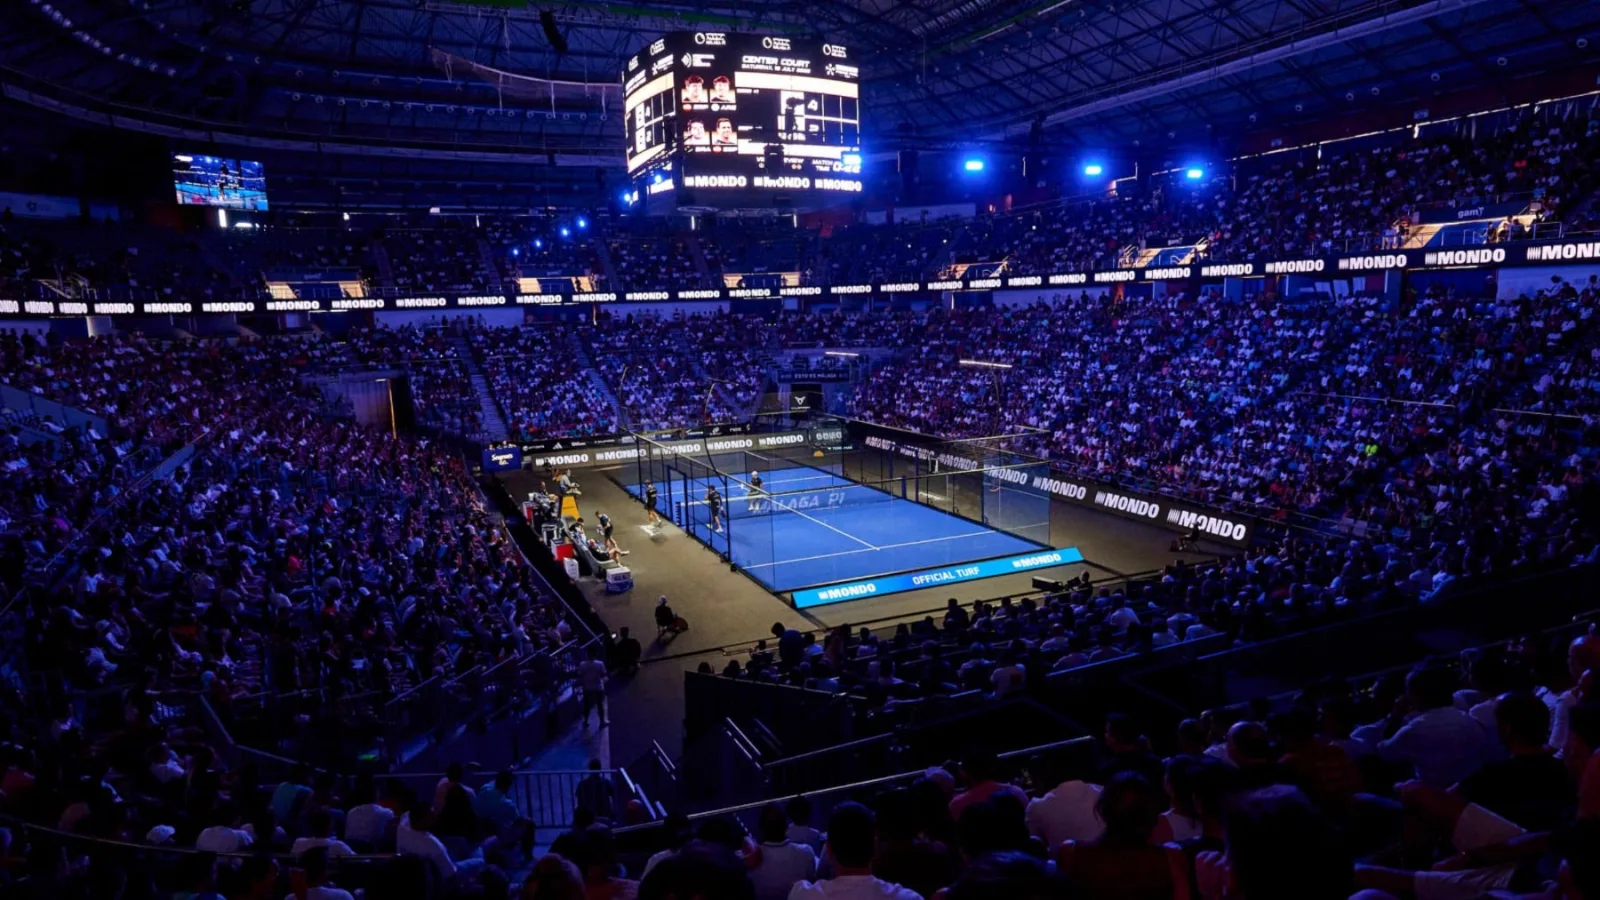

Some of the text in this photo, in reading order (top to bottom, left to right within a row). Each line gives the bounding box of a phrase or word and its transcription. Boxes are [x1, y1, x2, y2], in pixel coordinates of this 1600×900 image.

[742, 55, 811, 68] CENTER COURT
[695, 175, 747, 187] MONDO
[823, 178, 862, 192] MONDO
[100, 303, 135, 314] MONDO
[151, 303, 192, 313] MONDO
[211, 302, 255, 312] MONDO
[275, 300, 319, 310] MONDO
[340, 299, 384, 309] MONDO
[404, 297, 446, 307] MONDO
[465, 296, 506, 306] MONDO
[523, 294, 562, 303] MONDO
[579, 293, 617, 302] MONDO
[633, 292, 669, 301] MONDO
[685, 290, 720, 299] MONDO
[736, 288, 771, 298] MONDO
[787, 286, 821, 296] MONDO
[838, 285, 872, 294] MONDO
[887, 283, 919, 292] MONDO
[933, 281, 963, 290] MONDO
[975, 279, 1001, 288] MONDO
[1014, 276, 1042, 286] MONDO
[1055, 274, 1086, 284] MONDO
[1100, 270, 1136, 282] MONDO
[1152, 267, 1191, 279] MONDO
[1209, 263, 1253, 277] MONDO
[1275, 259, 1325, 274] MONDO
[1349, 254, 1408, 270] MONDO
[1437, 248, 1506, 265] MONDO
[714, 439, 753, 450] MONDO
[766, 434, 804, 446] MONDO
[943, 454, 979, 471] MONDO
[989, 466, 1028, 485] MONDO
[1040, 477, 1087, 500] MONDO
[1104, 492, 1160, 518] MONDO
[1178, 509, 1247, 541] MONDO
[828, 553, 1062, 600] MONDO OFFICIAL TURF MONDO
